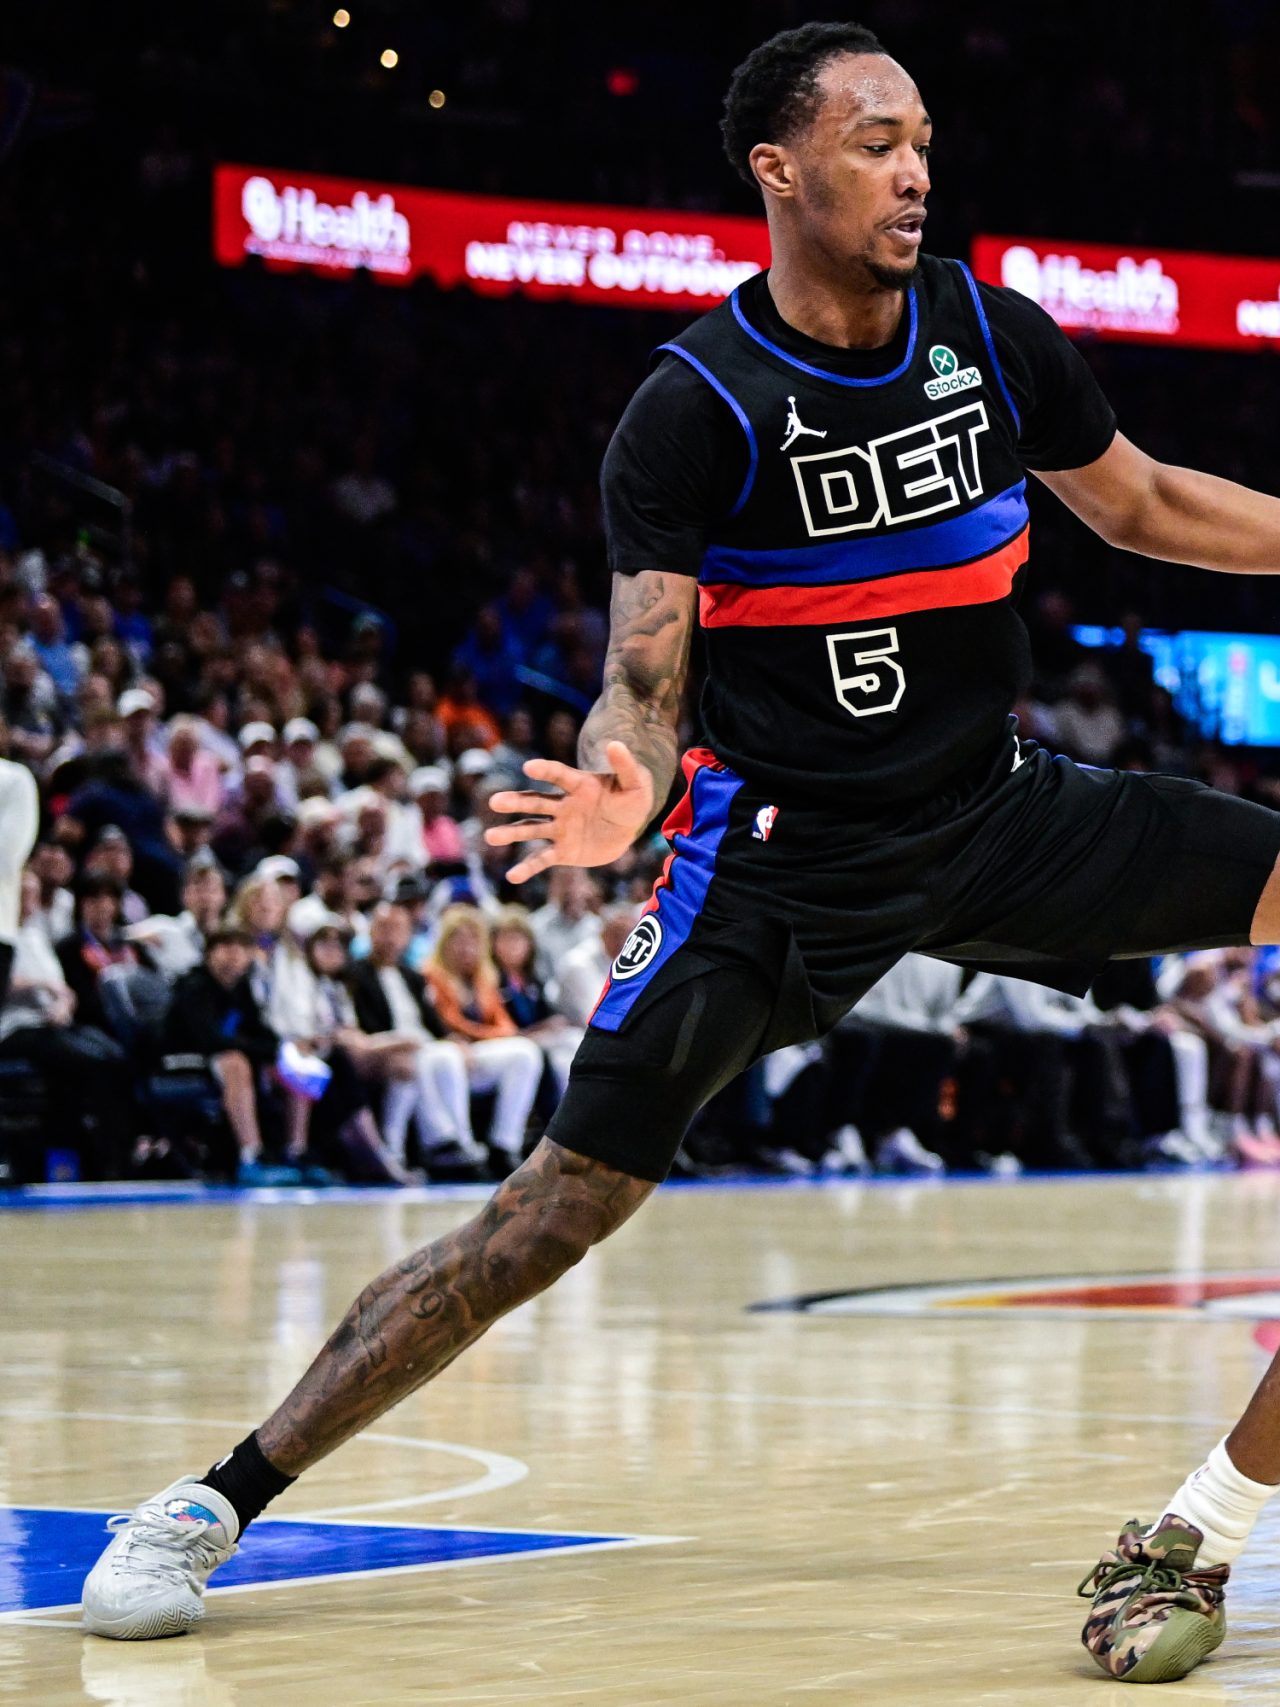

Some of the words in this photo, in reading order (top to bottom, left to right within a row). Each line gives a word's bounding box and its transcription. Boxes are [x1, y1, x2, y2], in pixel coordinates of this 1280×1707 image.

[507, 221, 616, 254] NEVER
[466, 241, 585, 287] NEVER
[927, 370, 980, 397] StockX
[790, 400, 990, 537] DET
[826, 626, 906, 717] 5
